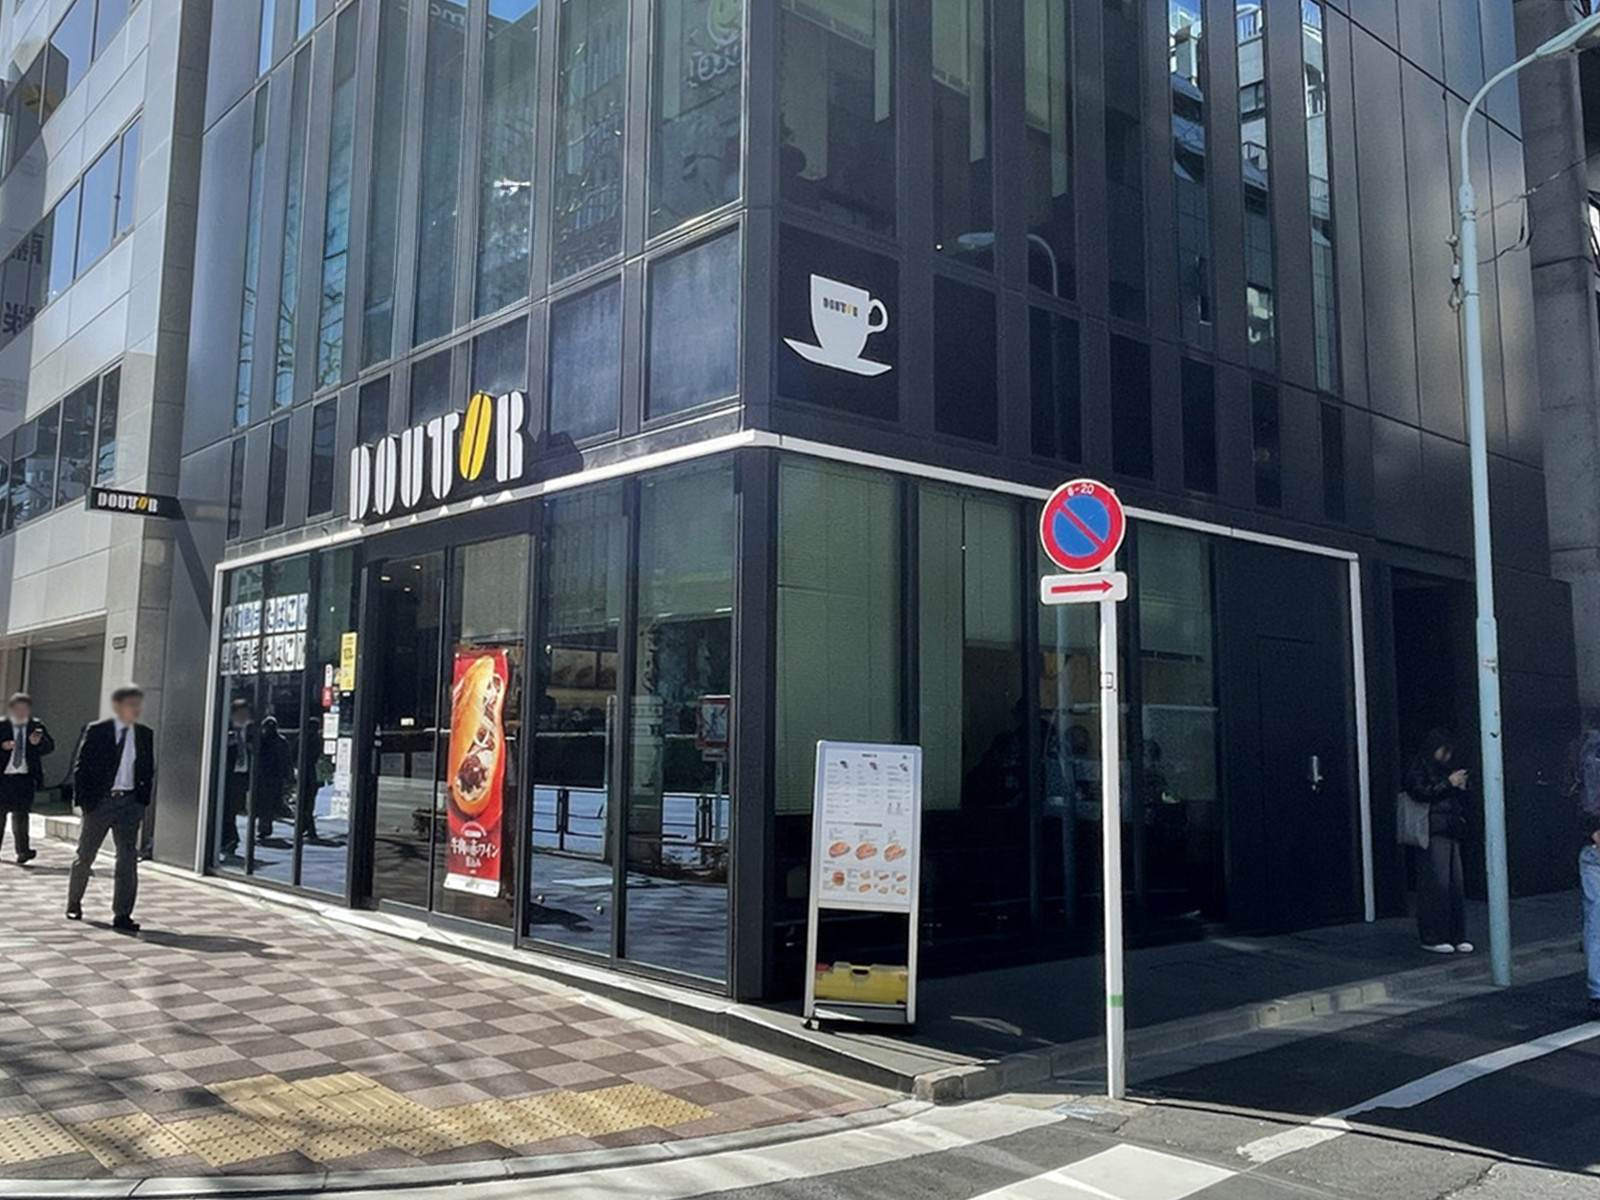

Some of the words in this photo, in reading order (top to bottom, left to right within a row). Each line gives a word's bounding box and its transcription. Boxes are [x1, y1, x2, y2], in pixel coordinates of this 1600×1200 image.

[823, 297, 858, 317] DOUTOR
[350, 391, 524, 521] DOUTOR
[97, 491, 158, 513] DOUTOR
